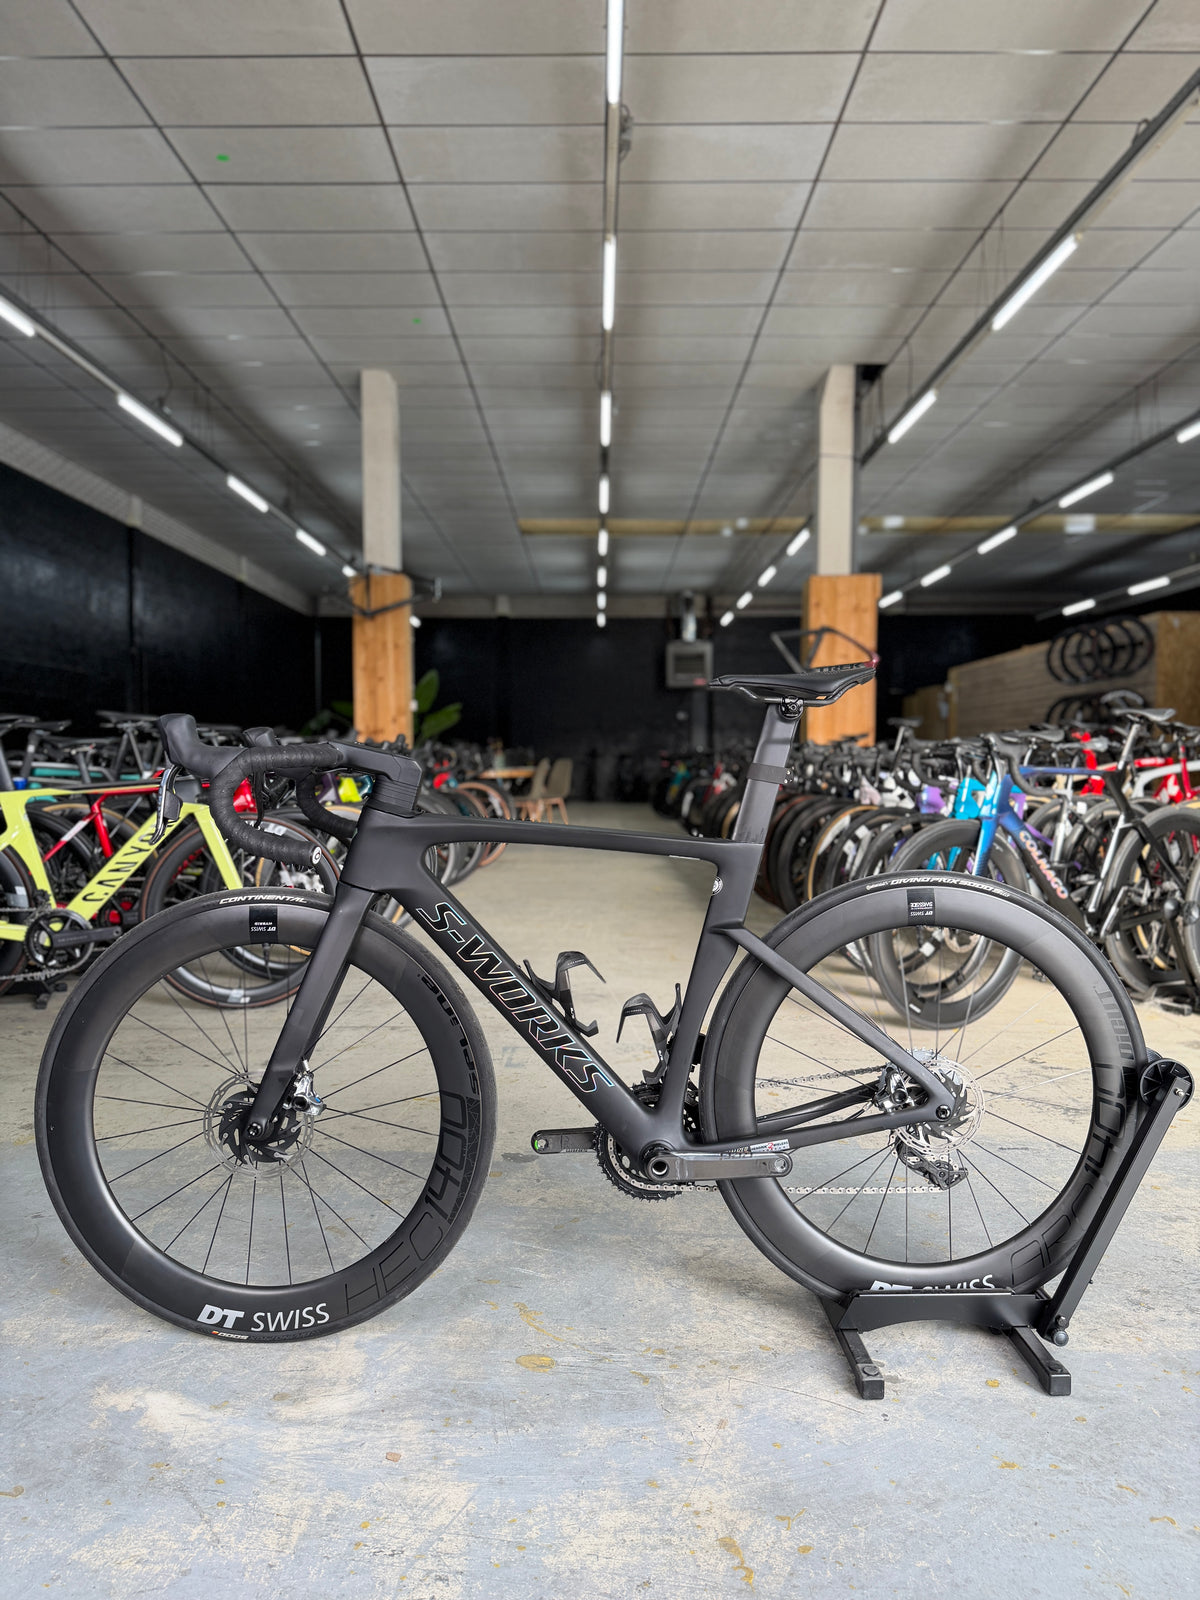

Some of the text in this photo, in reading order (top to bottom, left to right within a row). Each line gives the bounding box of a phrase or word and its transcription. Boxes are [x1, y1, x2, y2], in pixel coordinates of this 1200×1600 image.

[1019, 830, 1069, 900] COLNAGO
[218, 894, 307, 905] CONTINENTAL
[416, 902, 614, 1093] S-WORKS
[197, 1302, 330, 1332] DT SWISS
